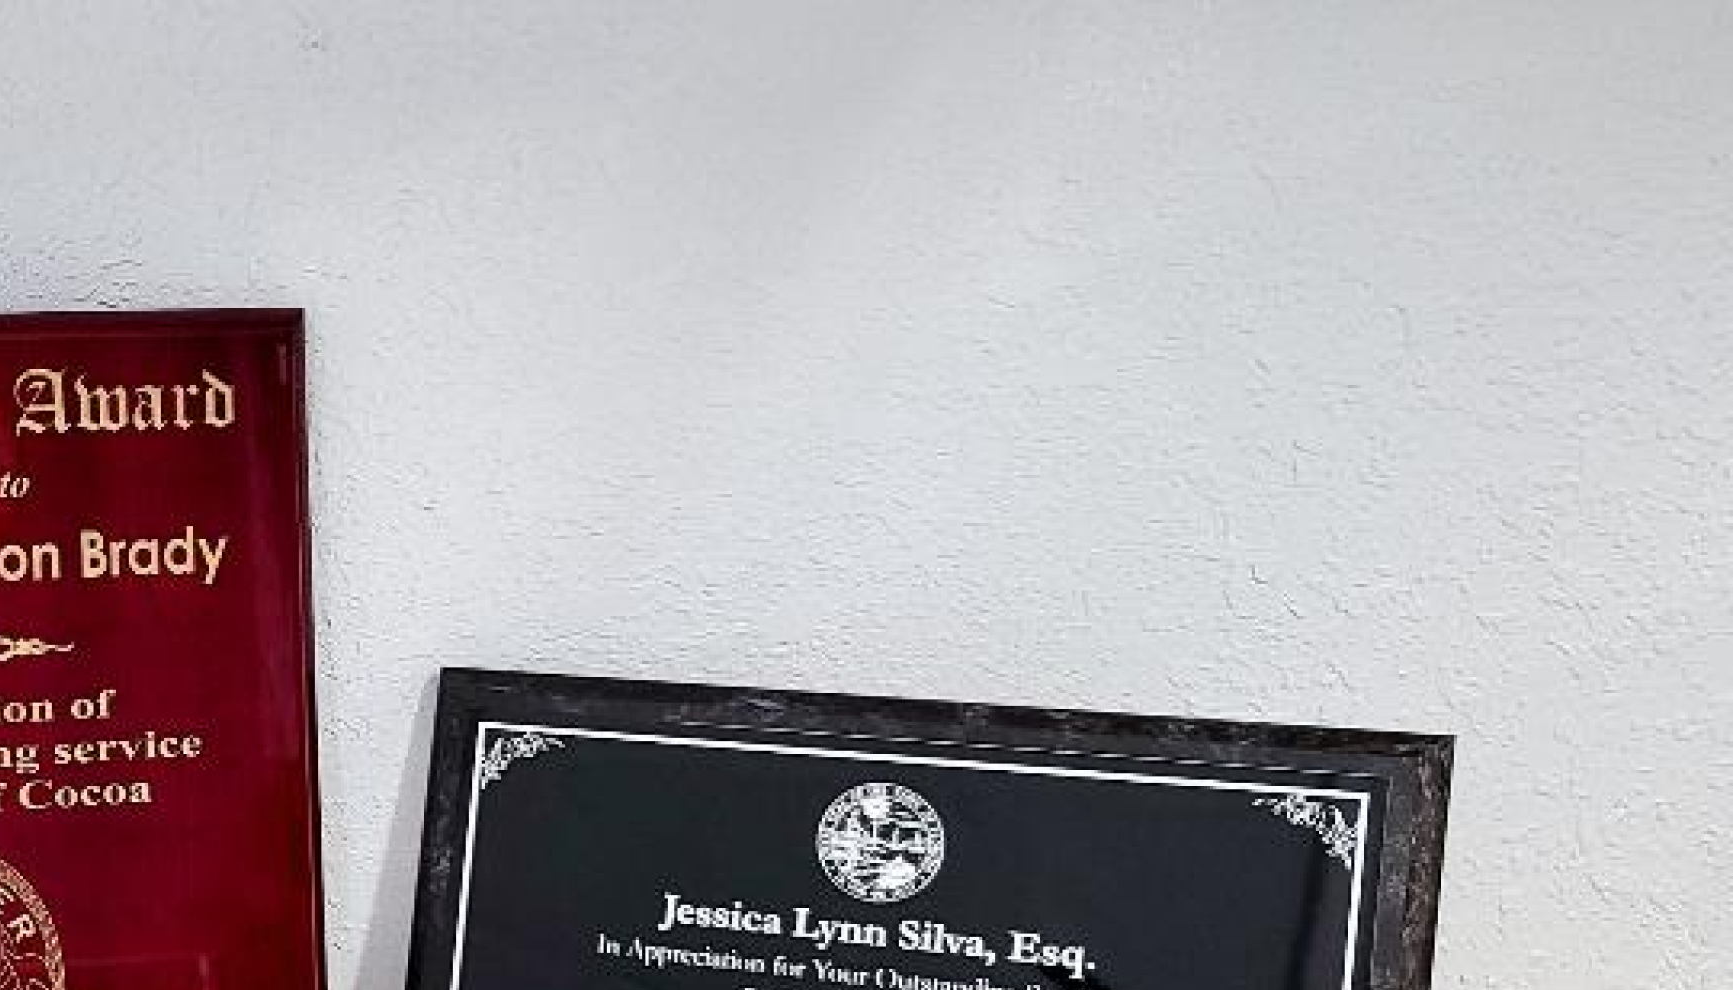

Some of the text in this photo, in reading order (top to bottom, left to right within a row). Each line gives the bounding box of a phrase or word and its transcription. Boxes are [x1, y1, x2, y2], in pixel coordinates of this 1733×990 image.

[13, 368, 236, 438] Award
[79, 525, 230, 585] Brady
[70, 688, 118, 720] of
[54, 730, 204, 765] service
[18, 779, 153, 809] Cocoa
[596, 932, 621, 957] In
[625, 936, 766, 974] Appreciation
[773, 954, 808, 979] for
[813, 958, 870, 987] Your
[657, 890, 1097, 981] Jessica Lynn Silva, Esq.
